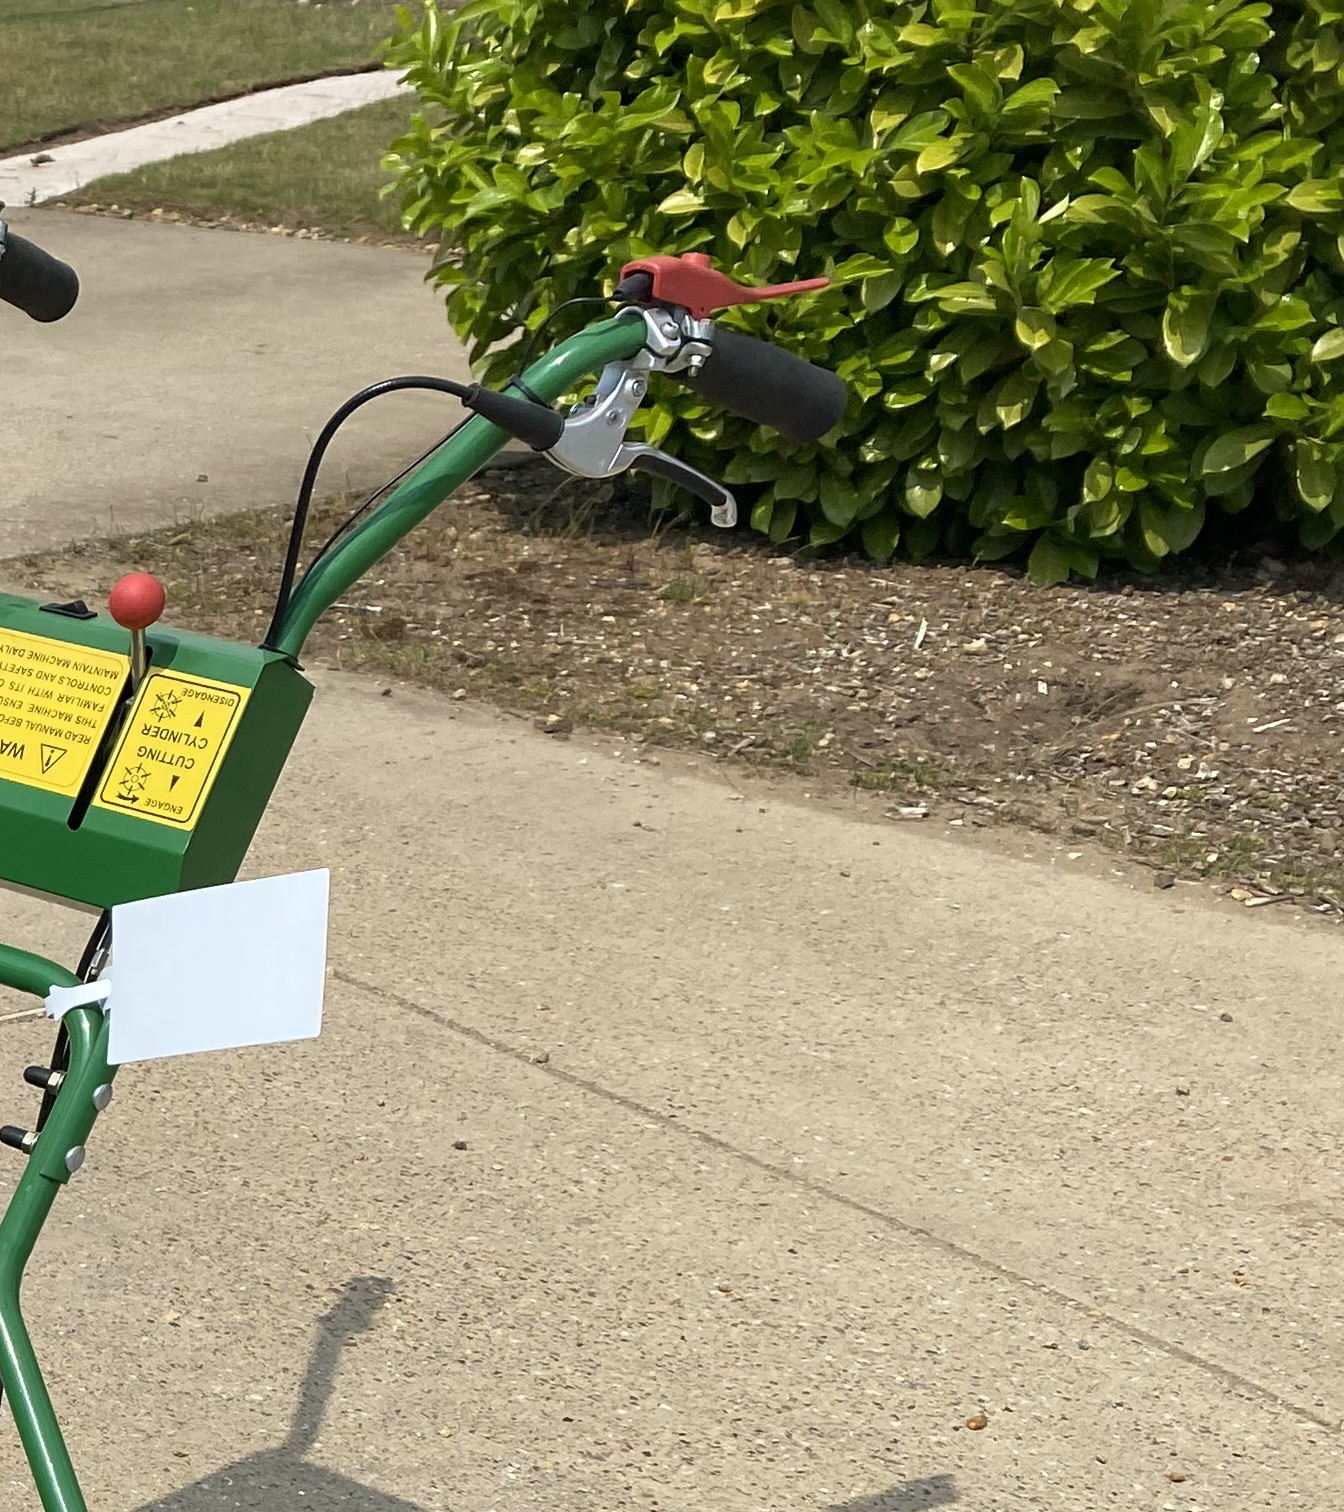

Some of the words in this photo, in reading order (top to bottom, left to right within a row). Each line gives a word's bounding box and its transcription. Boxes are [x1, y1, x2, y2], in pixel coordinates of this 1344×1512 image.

[26, 650, 71, 669] MACHINE
[35, 670, 56, 681] AND
[72, 663, 120, 680] MAINTAIN
[9, 681, 26, 692] ITS
[27, 685, 53, 700] WITH
[58, 676, 112, 696] CONTROLS
[56, 693, 105, 713] FAMILIAR
[181, 687, 235, 707] DISENGAGE
[25, 720, 64, 740] MANUAL
[75, 715, 98, 729] THIS
[64, 730, 92, 745] READ
[141, 723, 208, 750] CYLINDER
[136, 745, 196, 770] CUTTING
[143, 797, 184, 814] ENGAGE
